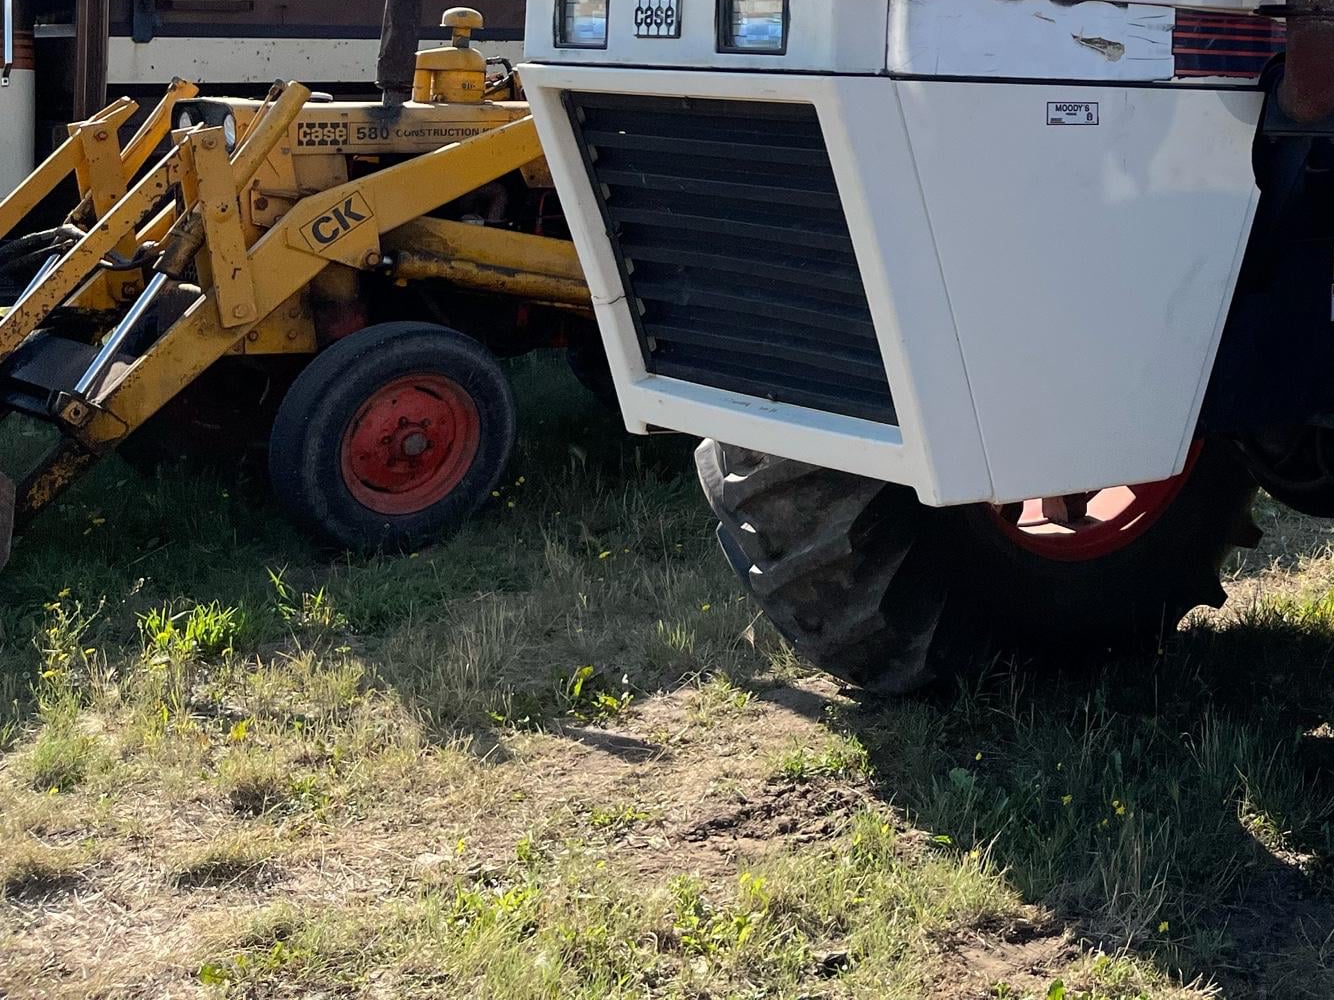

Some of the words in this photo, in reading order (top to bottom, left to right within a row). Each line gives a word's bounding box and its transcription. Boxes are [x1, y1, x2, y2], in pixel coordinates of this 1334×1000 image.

[356, 127, 390, 140] 580
[396, 127, 480, 138] CONSTRUCTION
[312, 198, 366, 244] CK
